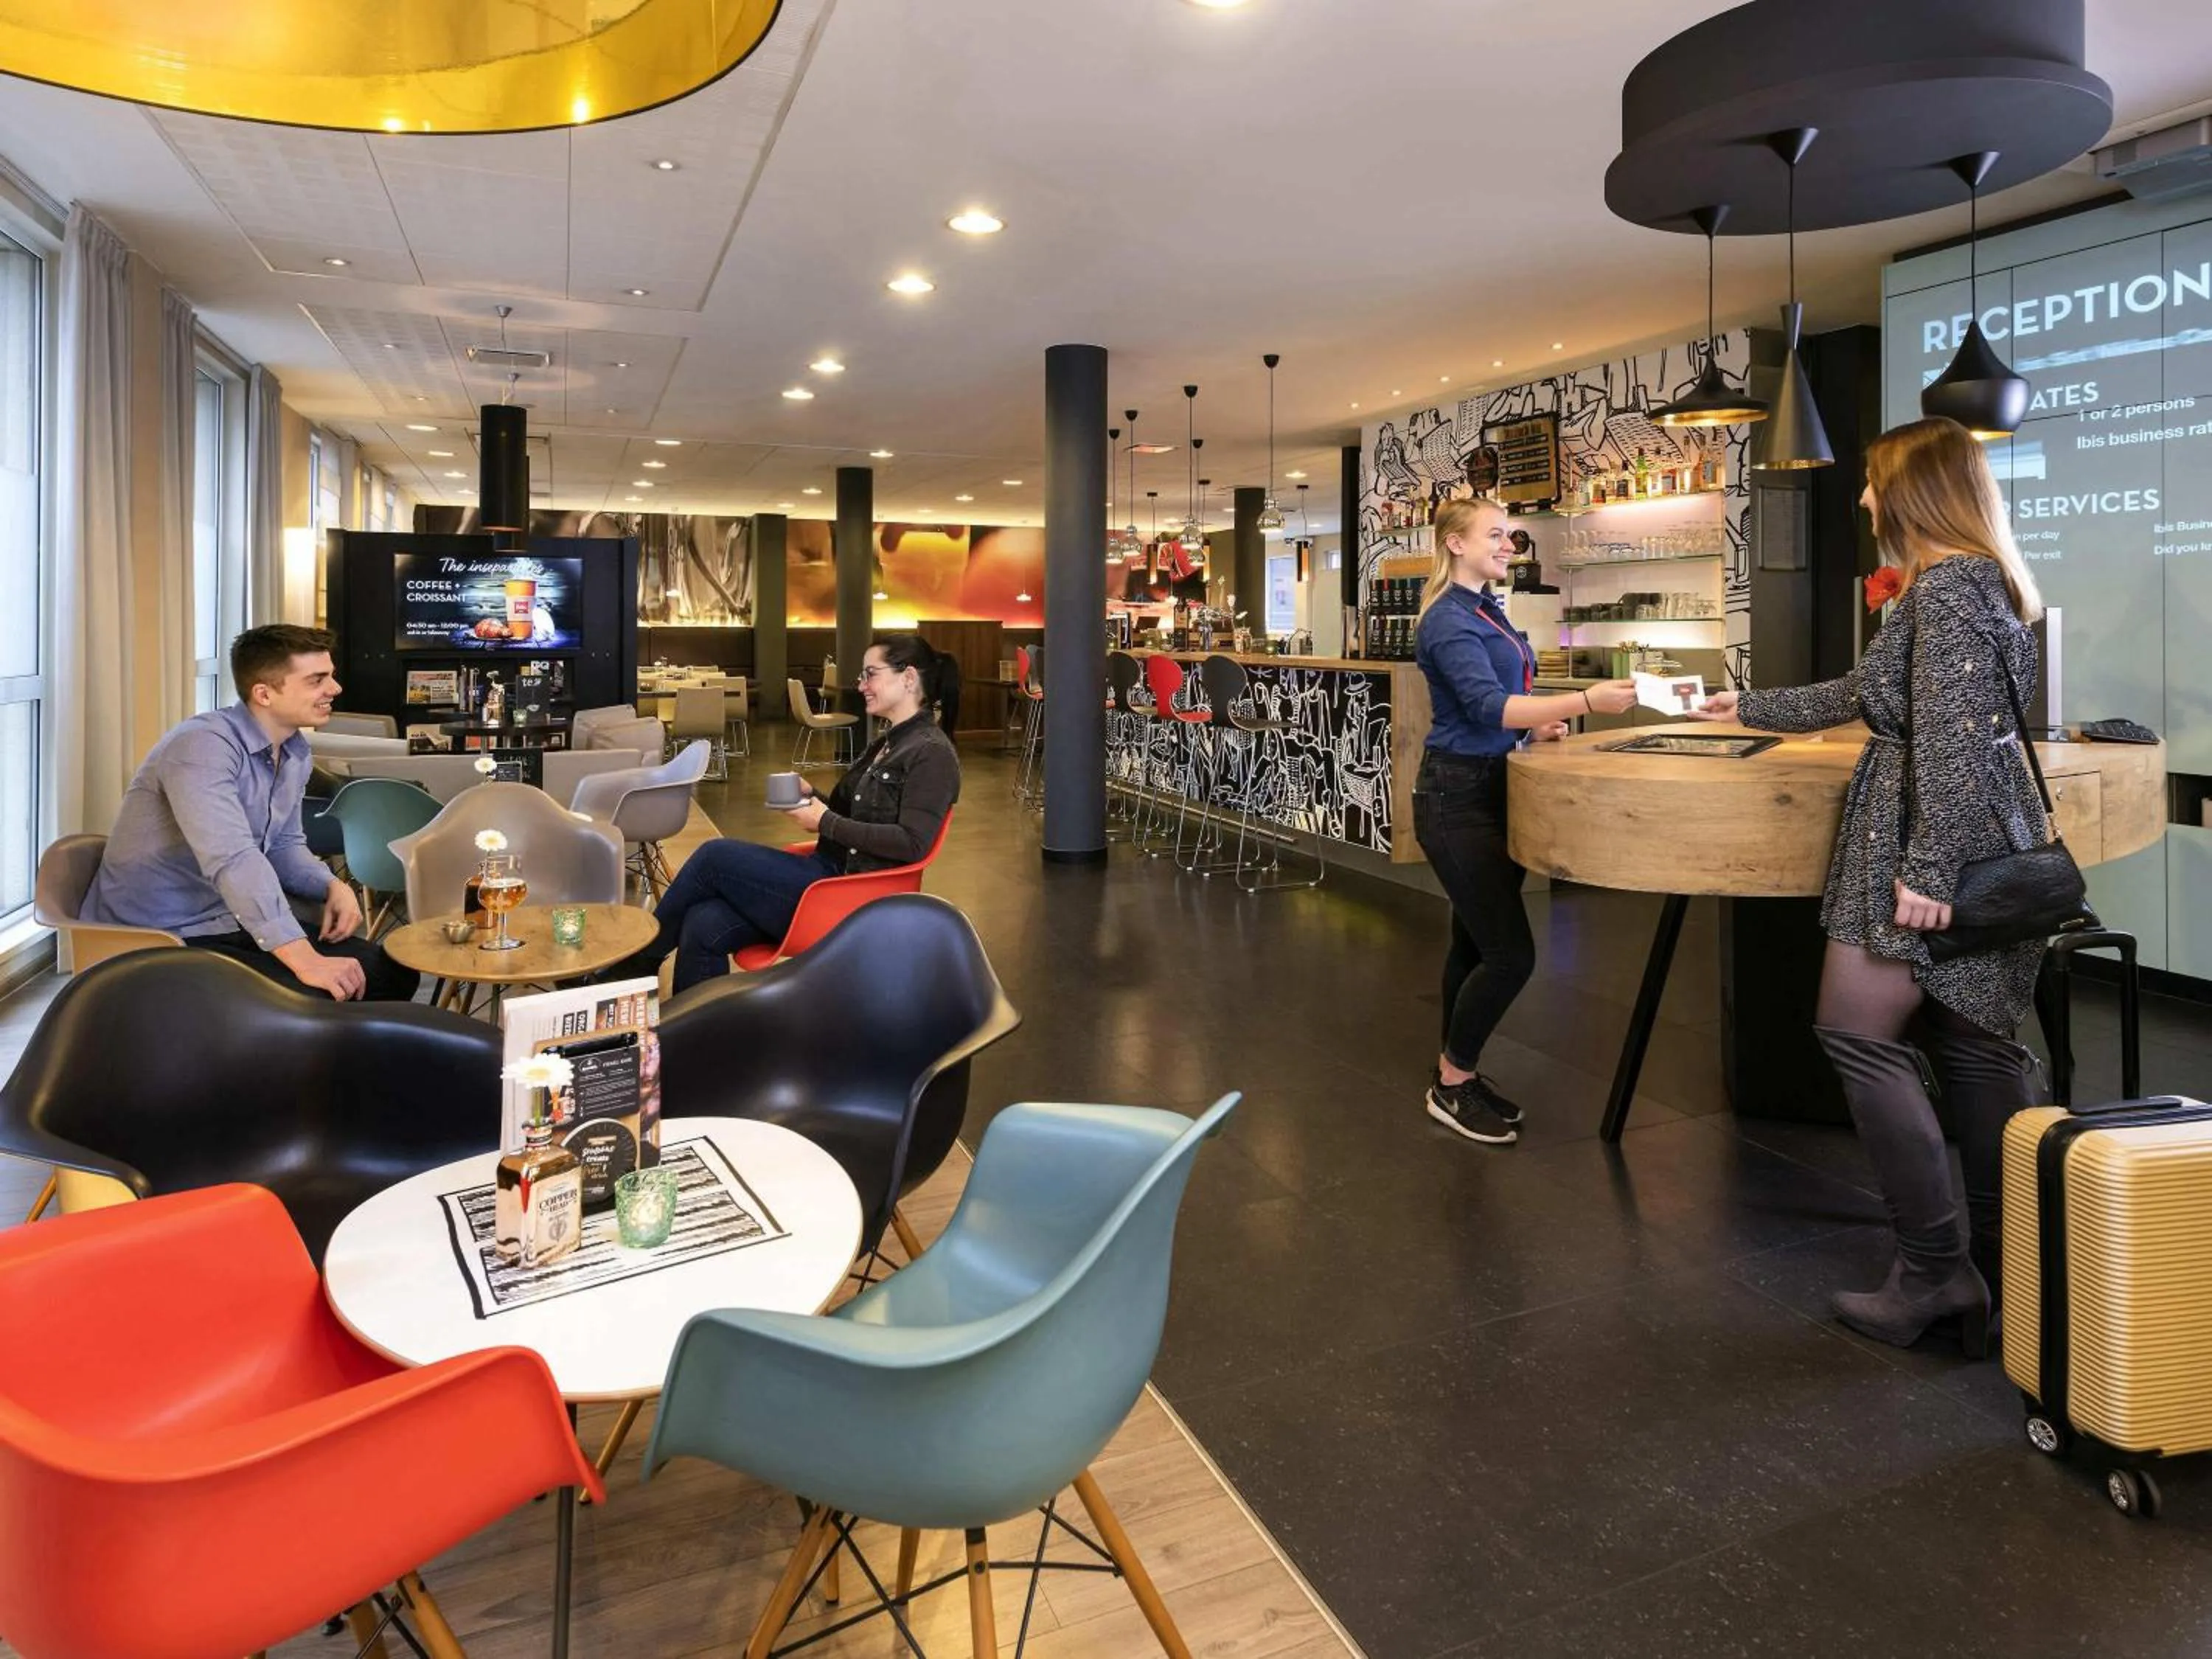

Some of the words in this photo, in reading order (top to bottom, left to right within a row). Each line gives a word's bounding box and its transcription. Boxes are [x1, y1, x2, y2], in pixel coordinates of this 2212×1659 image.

[1923, 262, 2211, 353] RECEPTION
[2029, 381, 2099, 411] ATES
[2090, 409, 2109, 420] or
[2111, 405, 2122, 418] 2
[2126, 397, 2196, 419] persons
[2077, 435, 2105, 449] Ibis
[2109, 427, 2185, 446] business
[2188, 420, 2212, 436] rat
[2018, 488, 2160, 518] SERVICES
[2177, 519, 2212, 532] Busin
[2041, 531, 2060, 541] day
[2175, 543, 2198, 555] you
[439, 557, 465, 574] The
[406, 580, 452, 591] COFFEE
[406, 593, 467, 603] CROISSANT
[539, 1189, 578, 1210] COPPER
